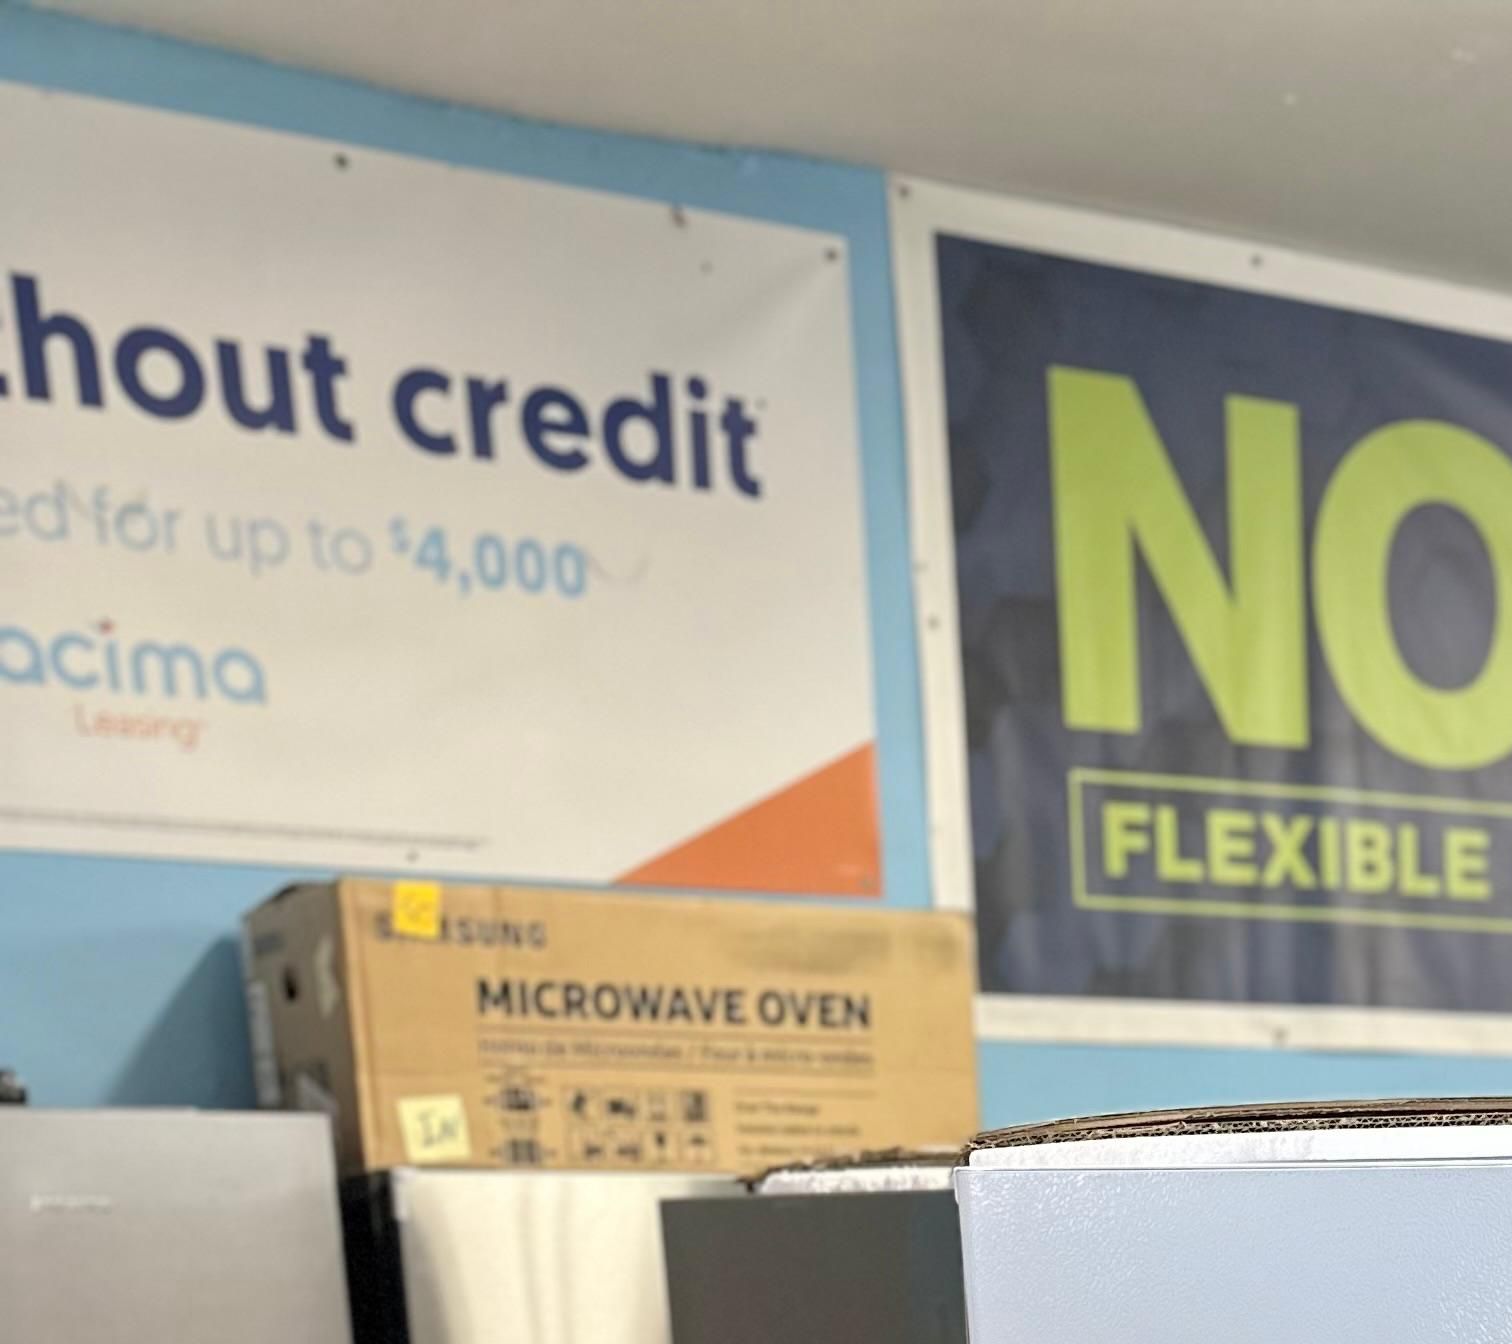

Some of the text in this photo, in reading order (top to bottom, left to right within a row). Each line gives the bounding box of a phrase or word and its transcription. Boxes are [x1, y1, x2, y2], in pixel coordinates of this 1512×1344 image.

[0, 270, 764, 500] hout credit
[92, 484, 182, 552] for
[204, 511, 292, 578] up
[308, 517, 374, 576] to
[388, 518, 589, 600] $4,000
[0, 617, 268, 706] acima
[1102, 800, 1491, 900] FLEXIBLE
[373, 912, 547, 951] SSUNG
[475, 978, 873, 1031] MICROWAVE OVEN
